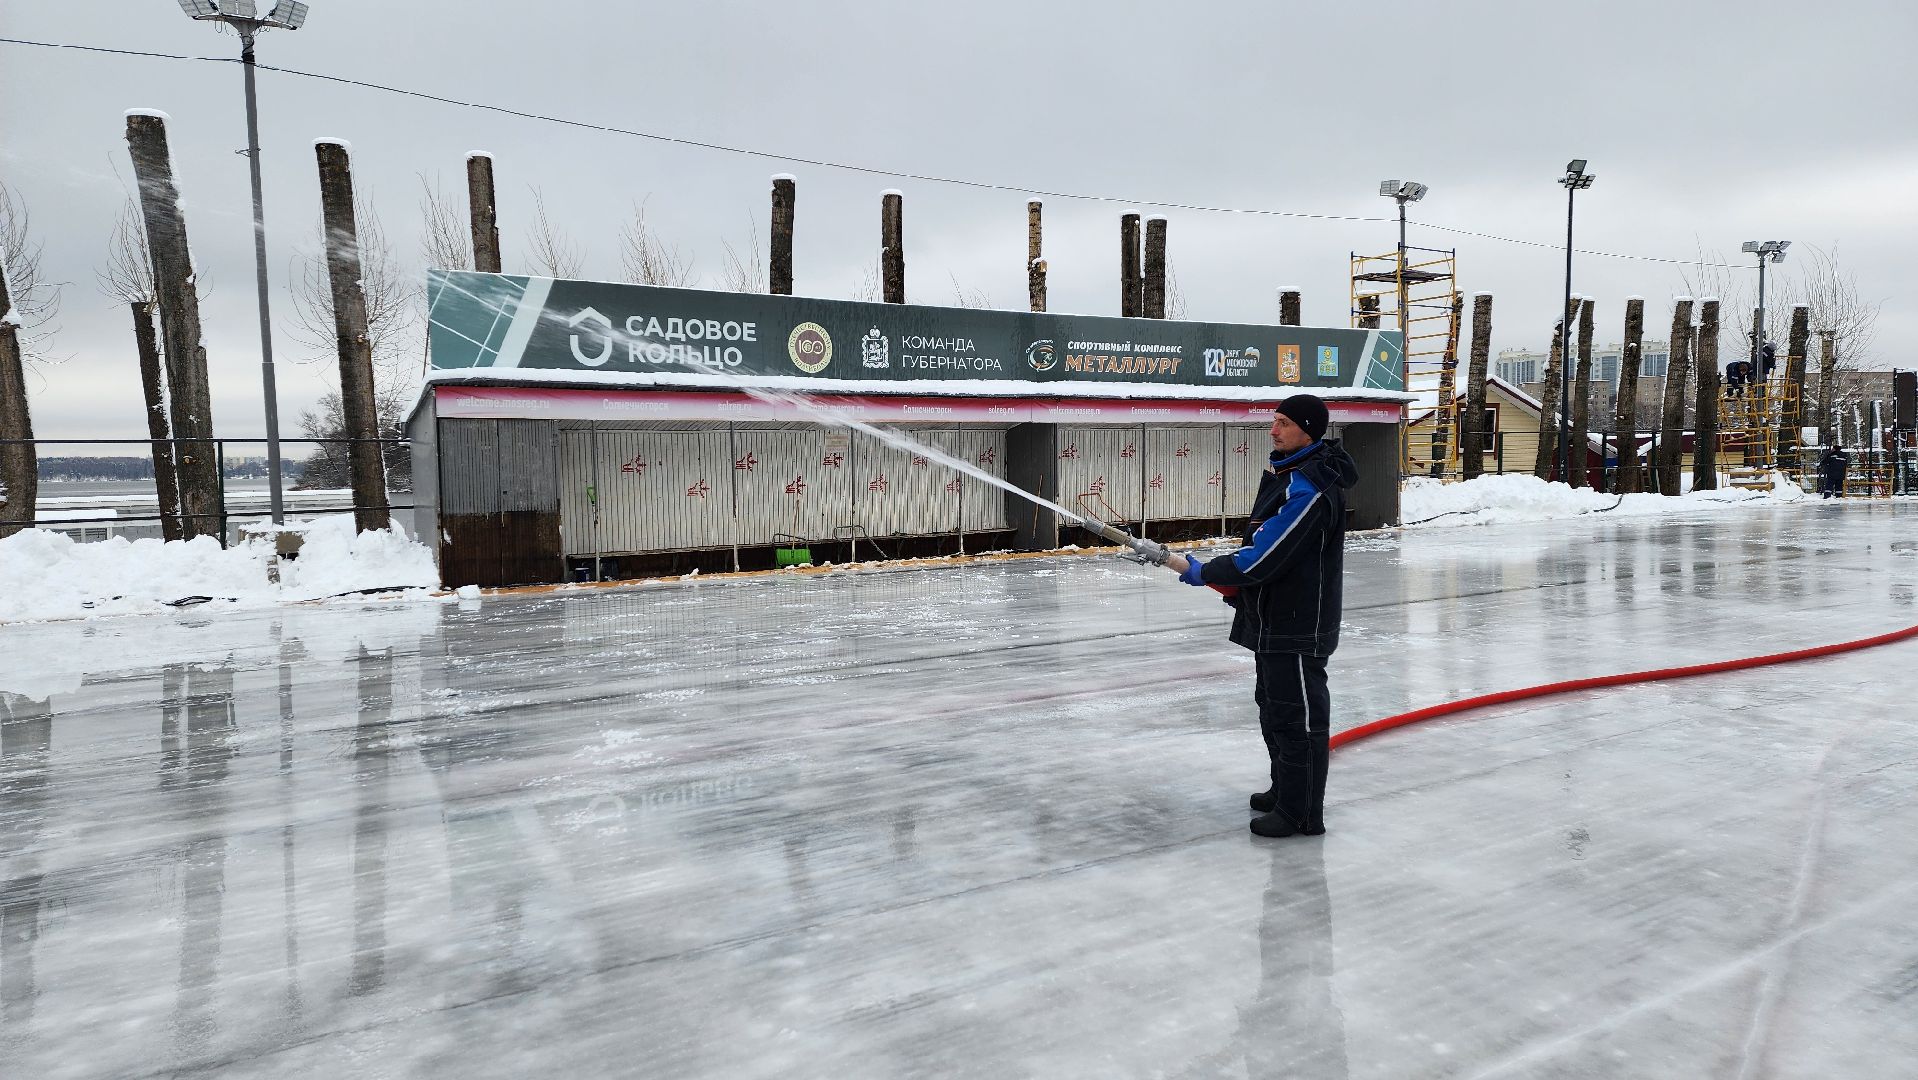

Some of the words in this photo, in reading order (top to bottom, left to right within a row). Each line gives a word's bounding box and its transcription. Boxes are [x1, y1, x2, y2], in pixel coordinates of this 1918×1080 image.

[625, 315, 757, 341] САДОВОЕ
[902, 336, 975, 352] КОМАНДА
[1134, 345, 1183, 354] комплекс
[628, 342, 743, 369] КОЛЬЦО
[902, 355, 1003, 371] ГУБЕРНАТОРА
[1064, 354, 1183, 375] МЕТАЛЛУРГ
